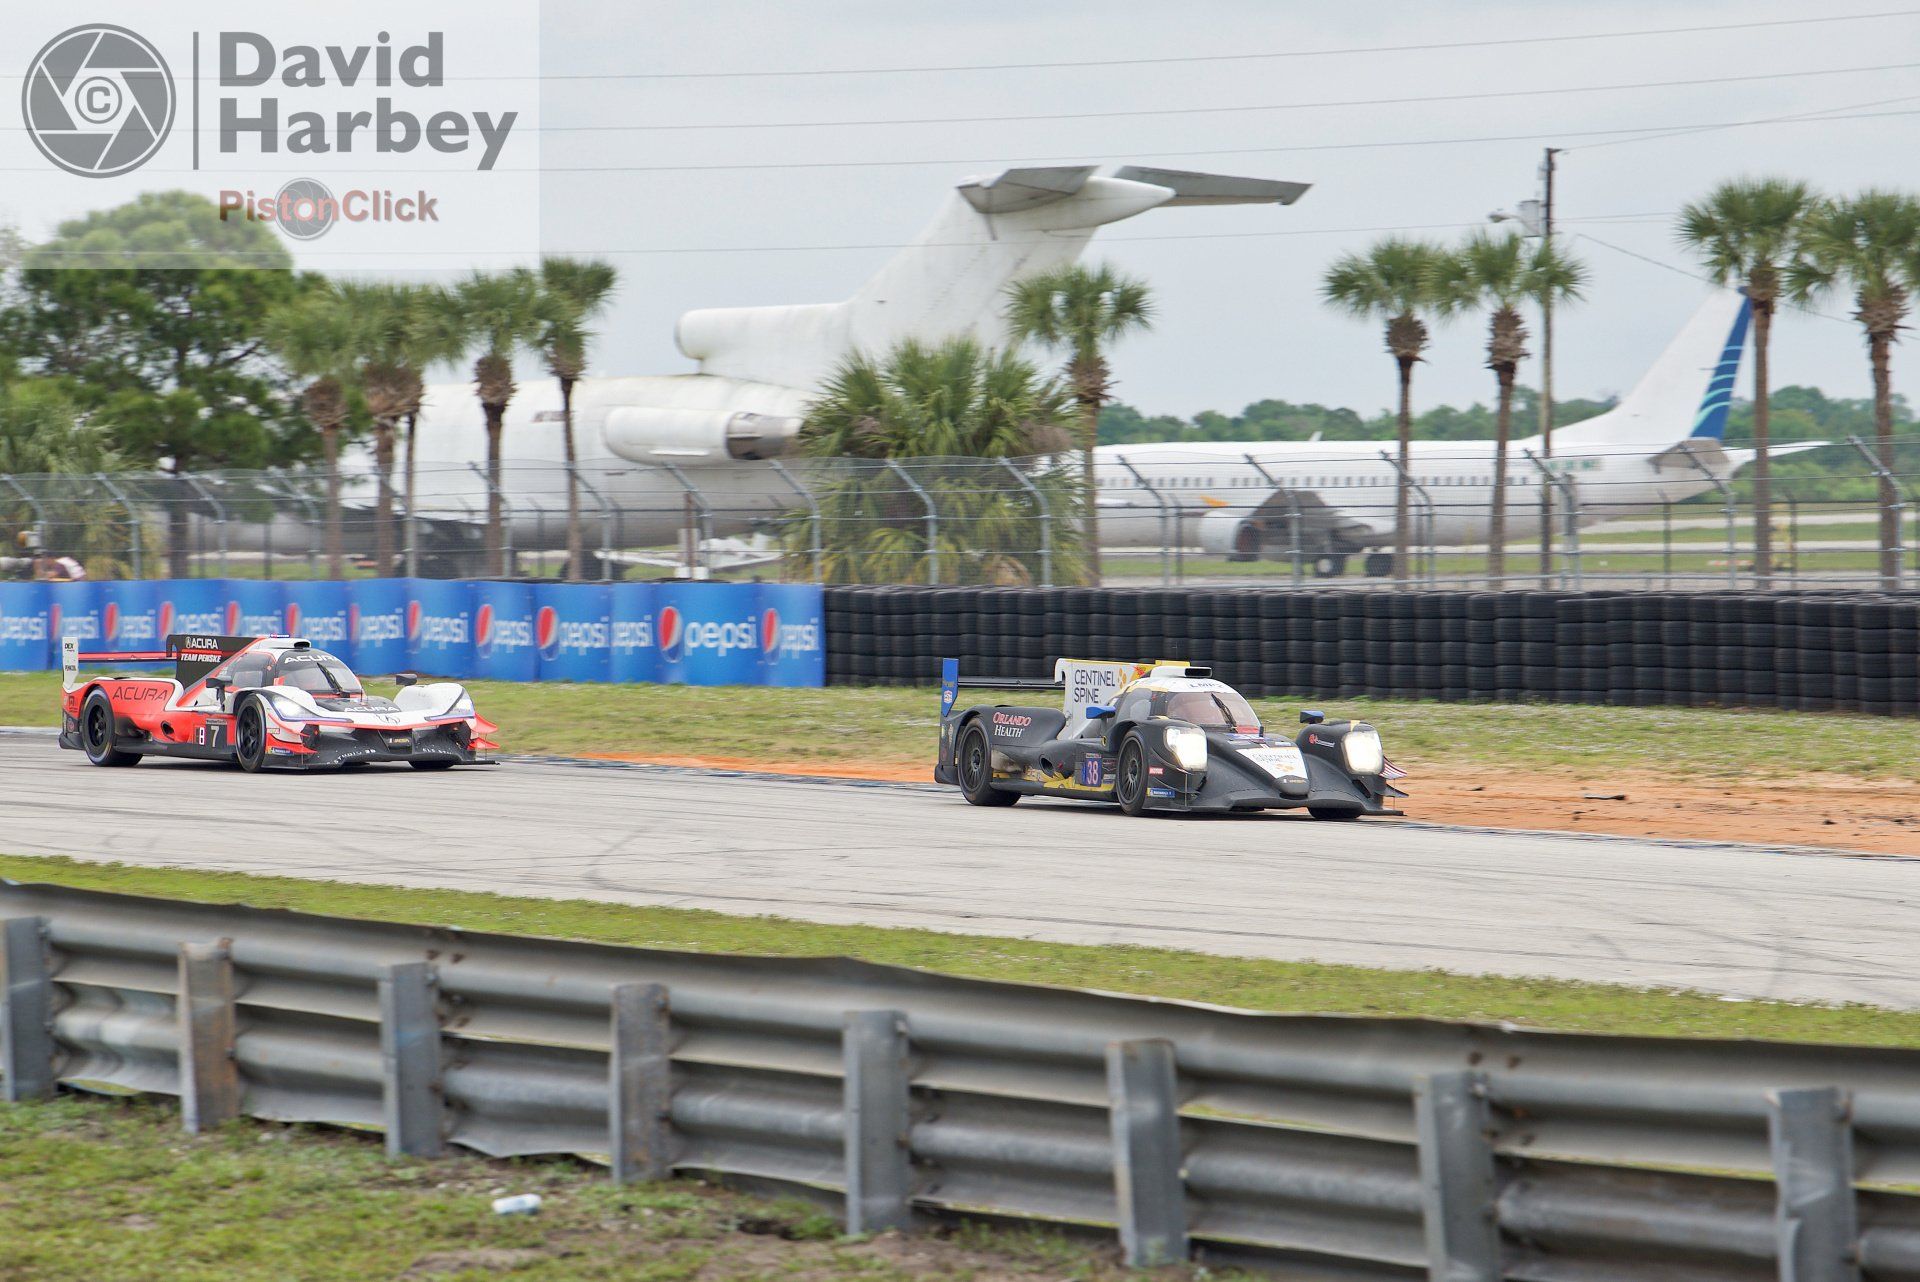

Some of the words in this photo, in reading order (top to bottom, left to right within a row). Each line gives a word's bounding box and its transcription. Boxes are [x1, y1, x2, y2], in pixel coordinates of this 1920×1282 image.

[421, 611, 469, 650] pepsi
[559, 615, 610, 656] pepsi
[684, 616, 757, 656] pepsi
[191, 638, 219, 649] ACURA
[180, 653, 198, 661] TEAM
[197, 654, 222, 663] PENSKE
[1074, 669, 1116, 687] CENTINEL
[112, 686, 168, 701] ACURA
[992, 711, 1032, 727] ORLANDO
[210, 725, 220, 748] 7
[1086, 760, 1099, 785] 38
